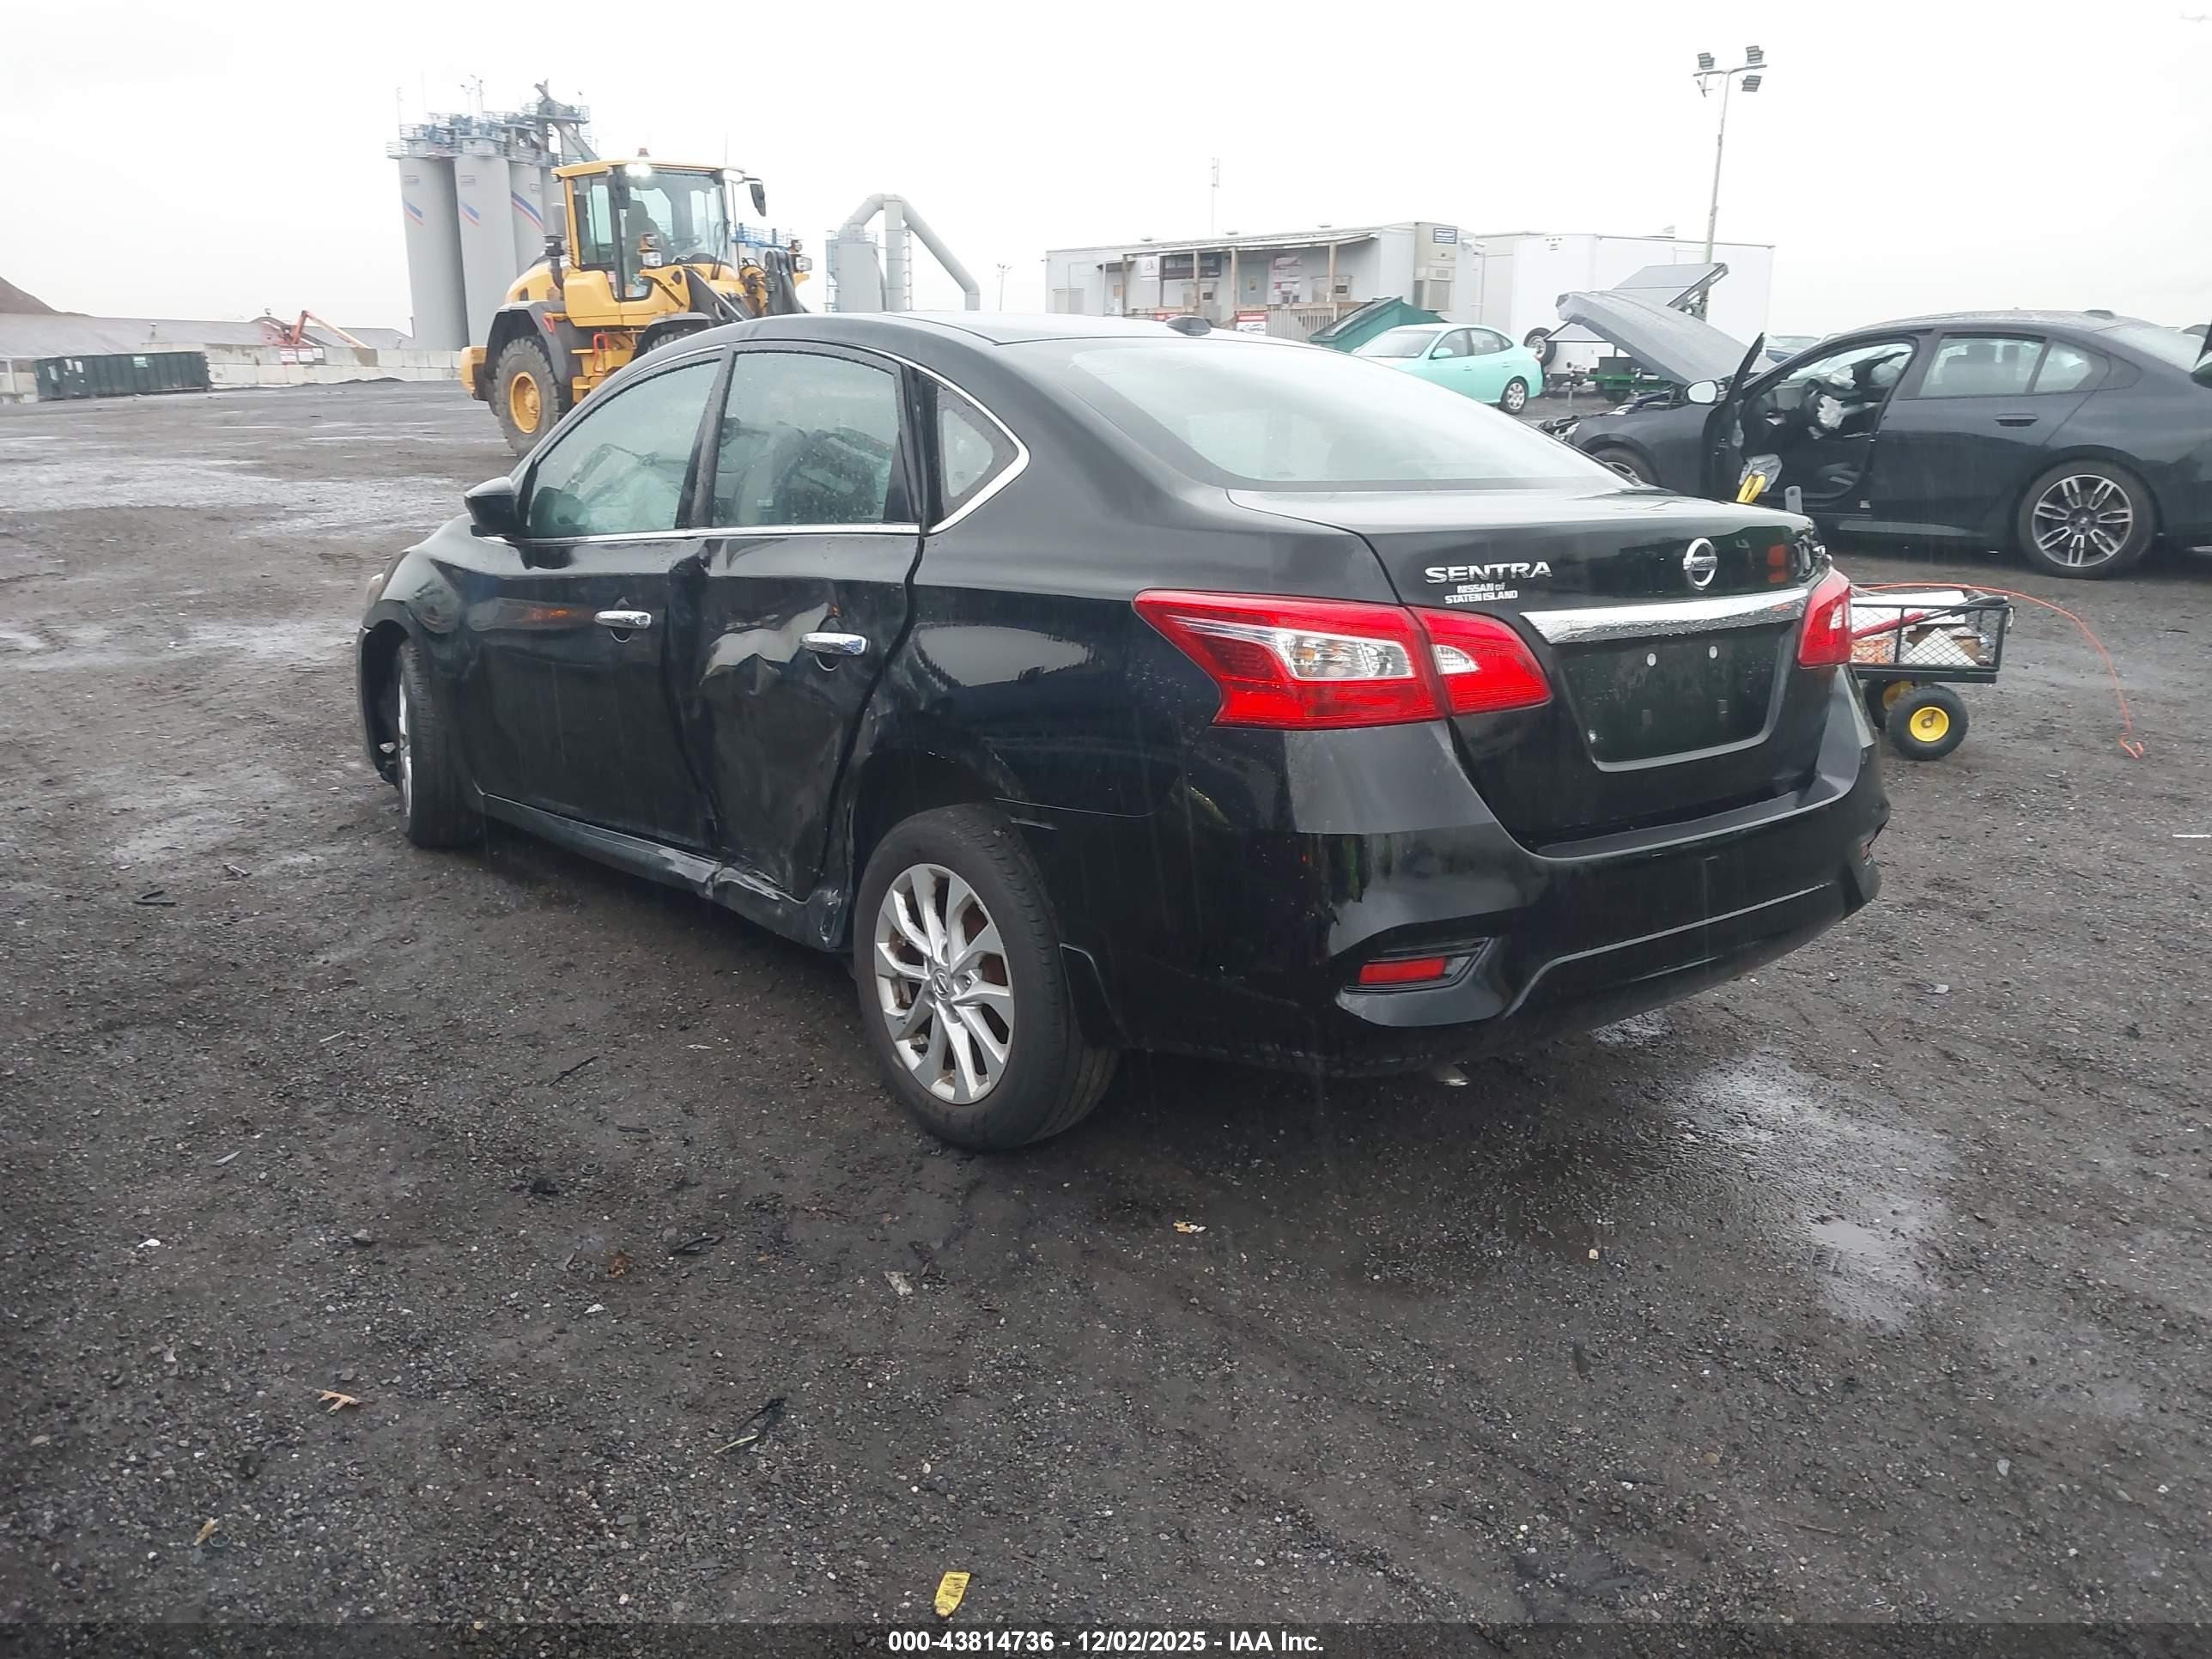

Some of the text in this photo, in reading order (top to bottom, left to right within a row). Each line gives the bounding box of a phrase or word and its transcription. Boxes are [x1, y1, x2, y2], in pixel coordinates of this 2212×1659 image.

[1425, 561, 1553, 584] SENTRA
[1456, 581, 1506, 594] NISSAN of
[1444, 590, 1519, 605] STATEN ISLAND
